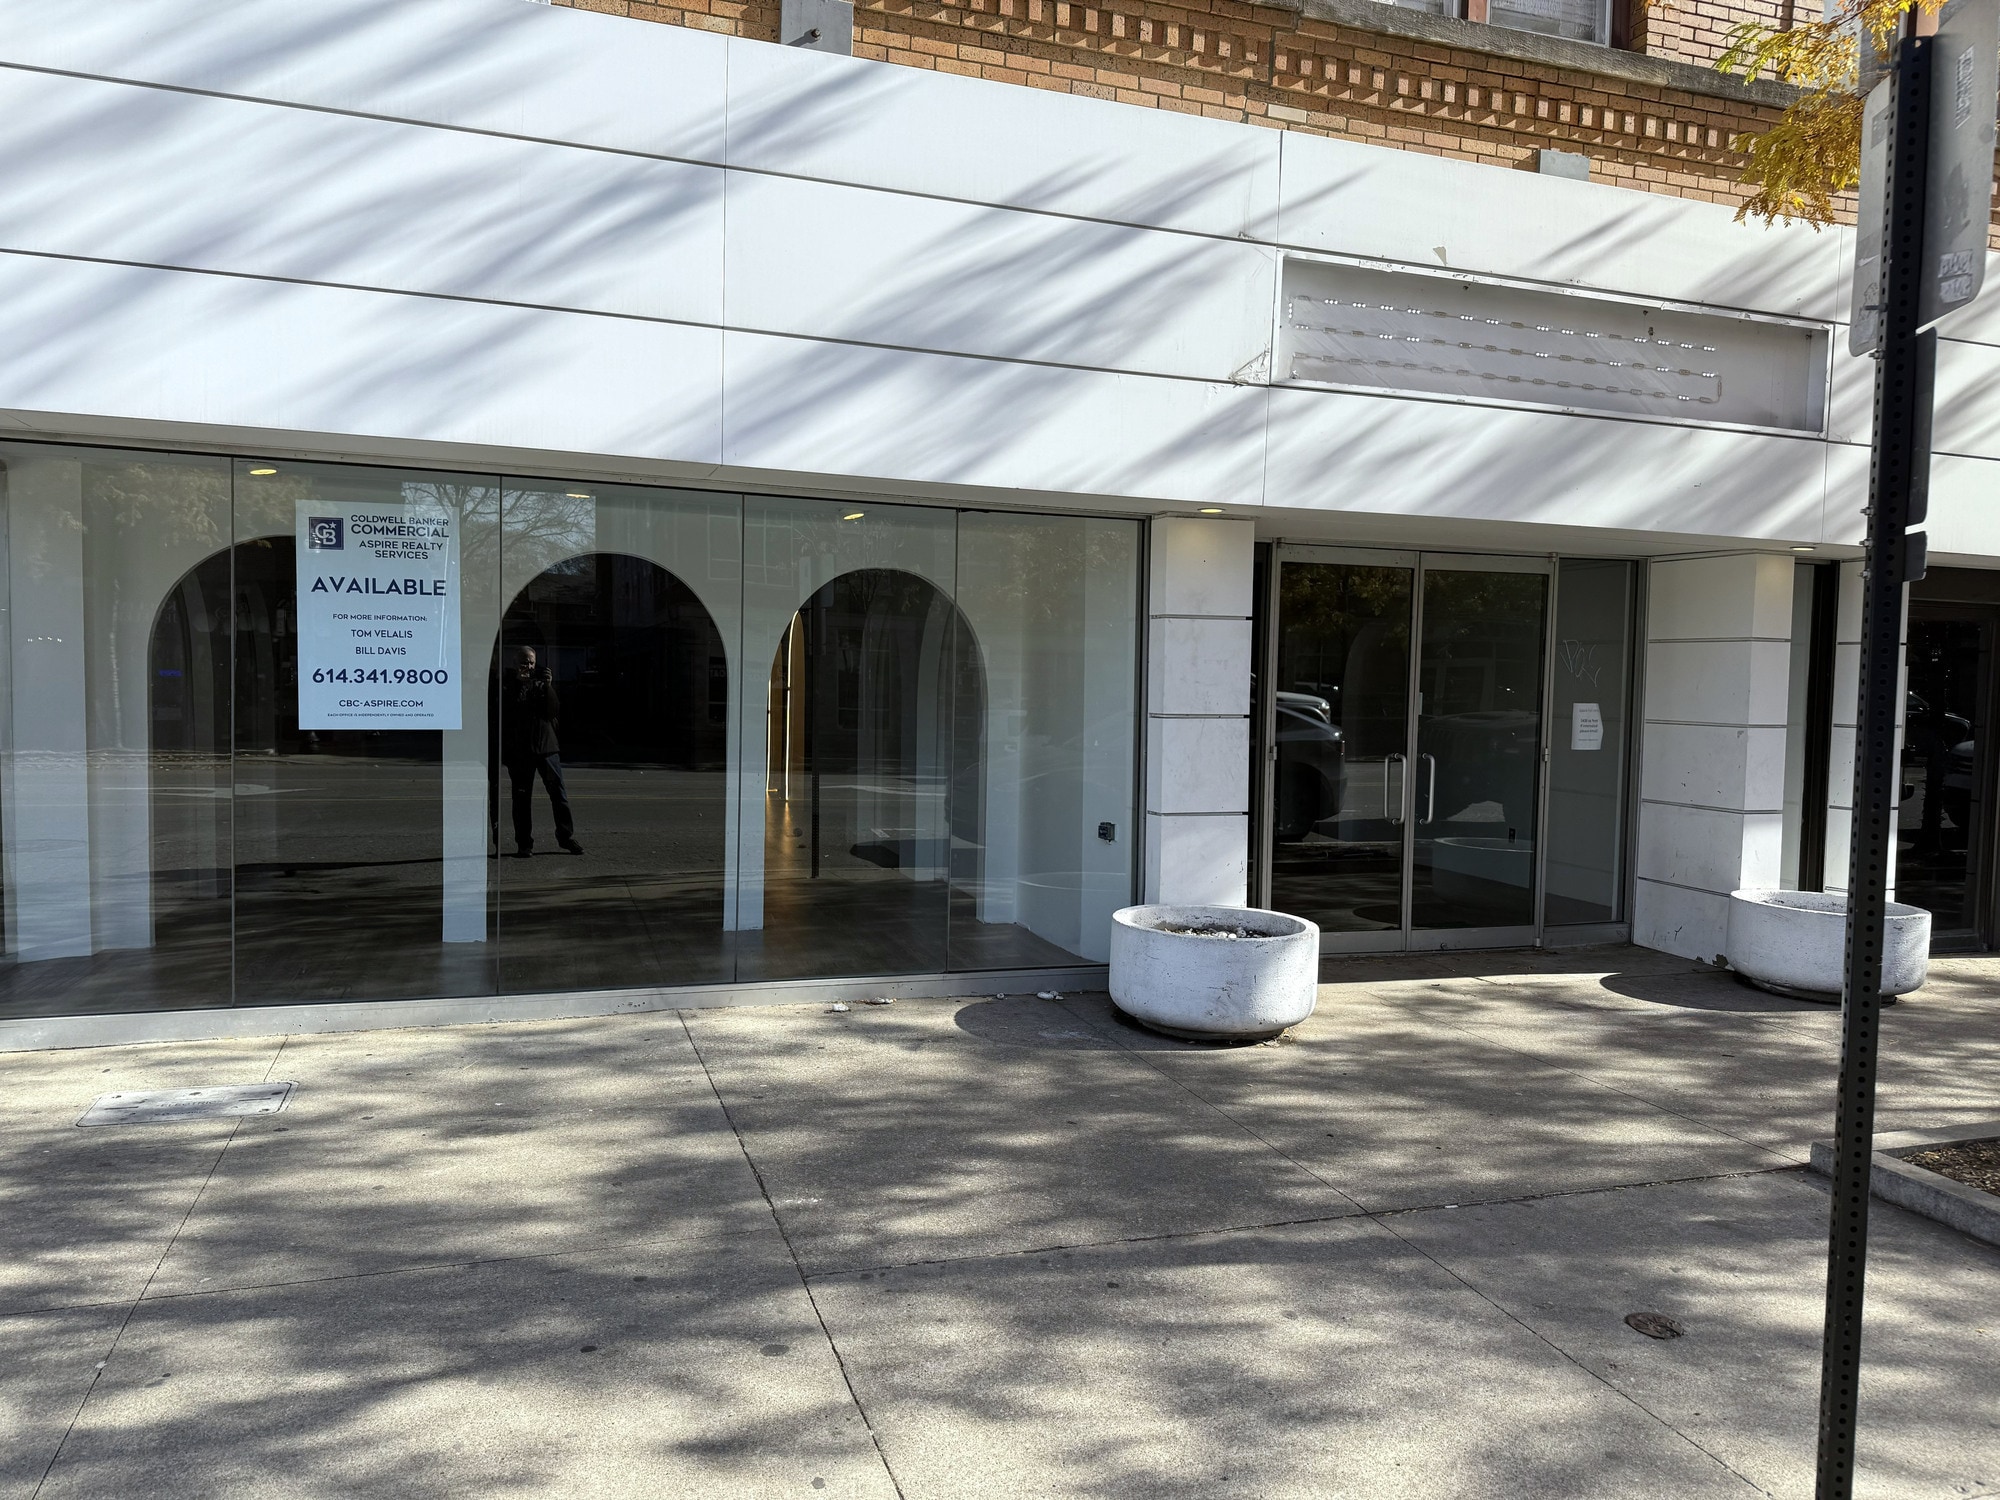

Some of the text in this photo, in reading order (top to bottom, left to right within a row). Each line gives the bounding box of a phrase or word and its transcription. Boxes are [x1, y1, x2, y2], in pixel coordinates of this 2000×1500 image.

[351, 514, 449, 527] COLDWELL BANKER
[351, 524, 450, 537] COMMERCIAL
[359, 540, 443, 551] ASPIRE REALTY
[374, 550, 429, 559] SERVICES
[310, 576, 447, 597] AVAILABLE
[332, 613, 349, 621] FOR
[373, 614, 428, 622] INFORMATION:
[351, 629, 413, 639] TOM VELALIS
[355, 646, 407, 656] BILL DAVIS
[312, 667, 449, 685] 614.341.9800
[338, 699, 424, 708] CBC-ASPIRE.COM
